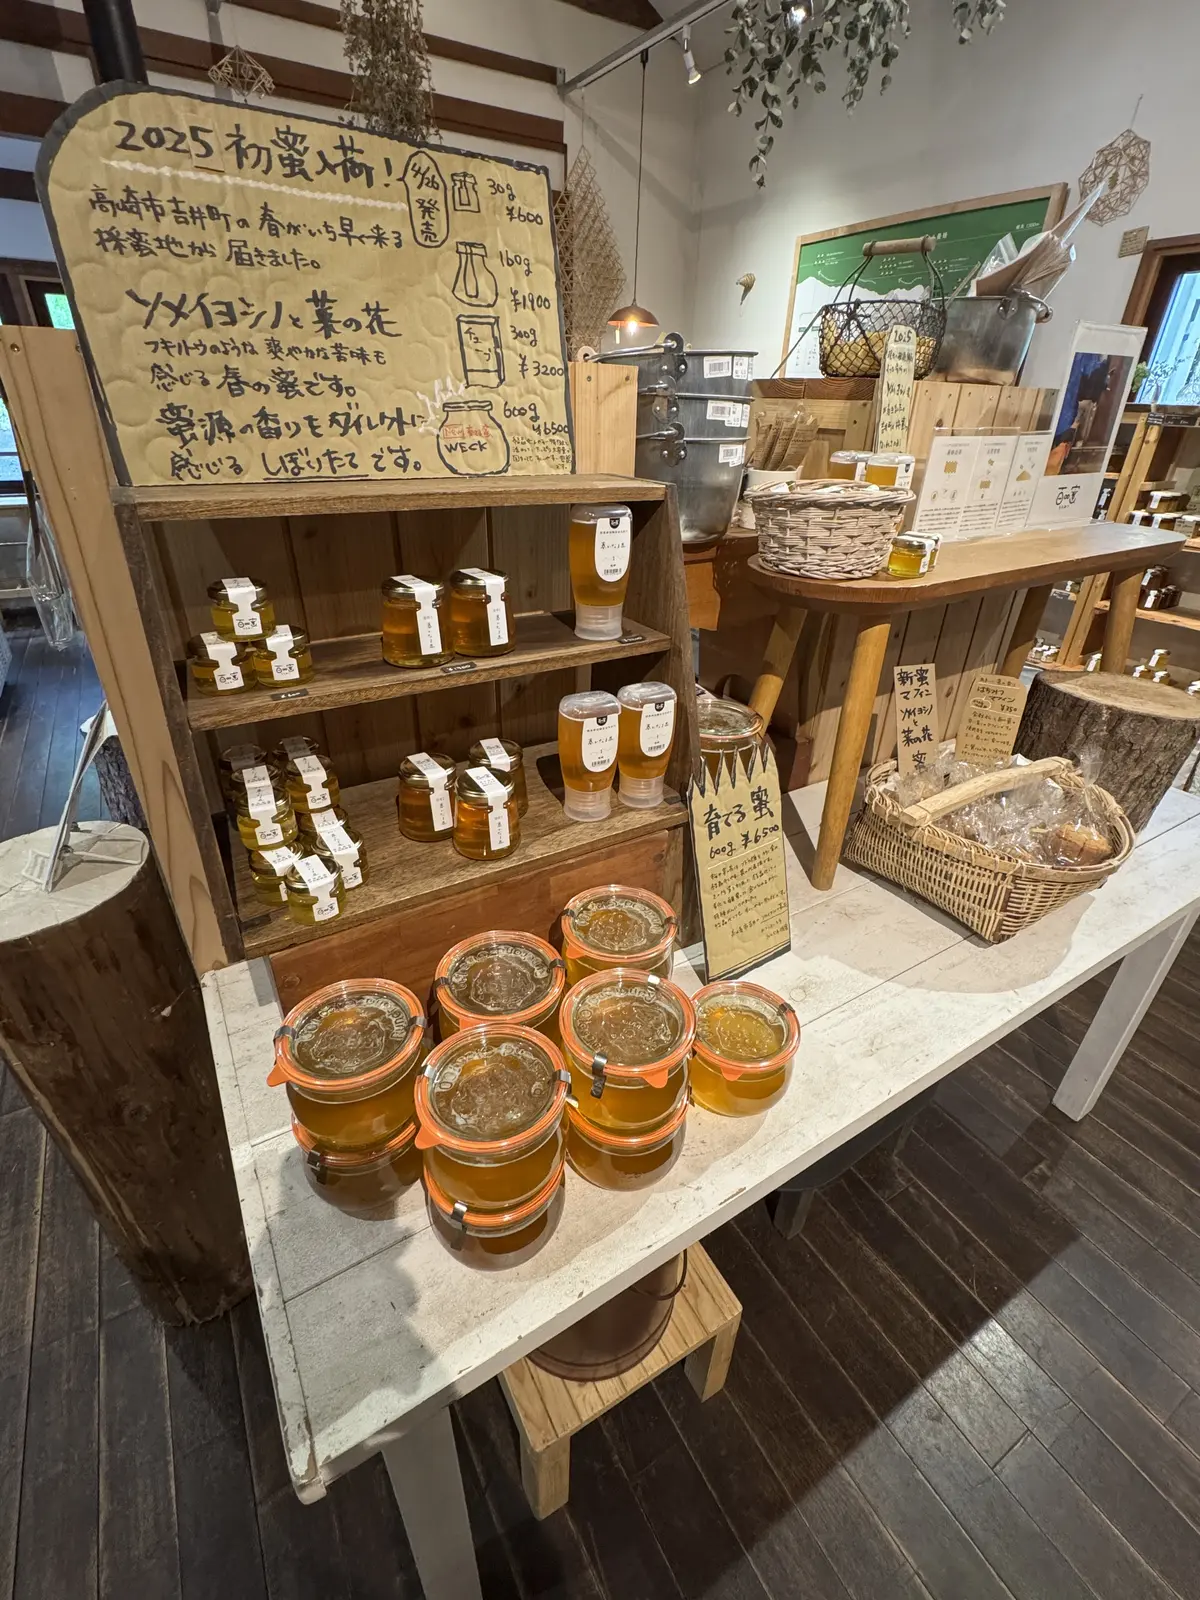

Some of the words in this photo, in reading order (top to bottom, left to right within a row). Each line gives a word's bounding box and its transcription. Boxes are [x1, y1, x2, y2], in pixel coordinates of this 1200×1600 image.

[410, 163, 440, 190] 4/26
[487, 178, 516, 202] 30g
[505, 206, 544, 226] ¥600
[500, 250, 533, 277] 160g
[510, 287, 551, 313] ¥1900
[510, 325, 538, 348] 300g
[503, 401, 541, 423] 600g
[444, 441, 488, 454] WECK
[897, 667, 930, 687] 新蜜
[703, 786, 775, 842] 育てる蜜
[709, 841, 737, 859] 600g
[740, 824, 780, 850] ¥6500
